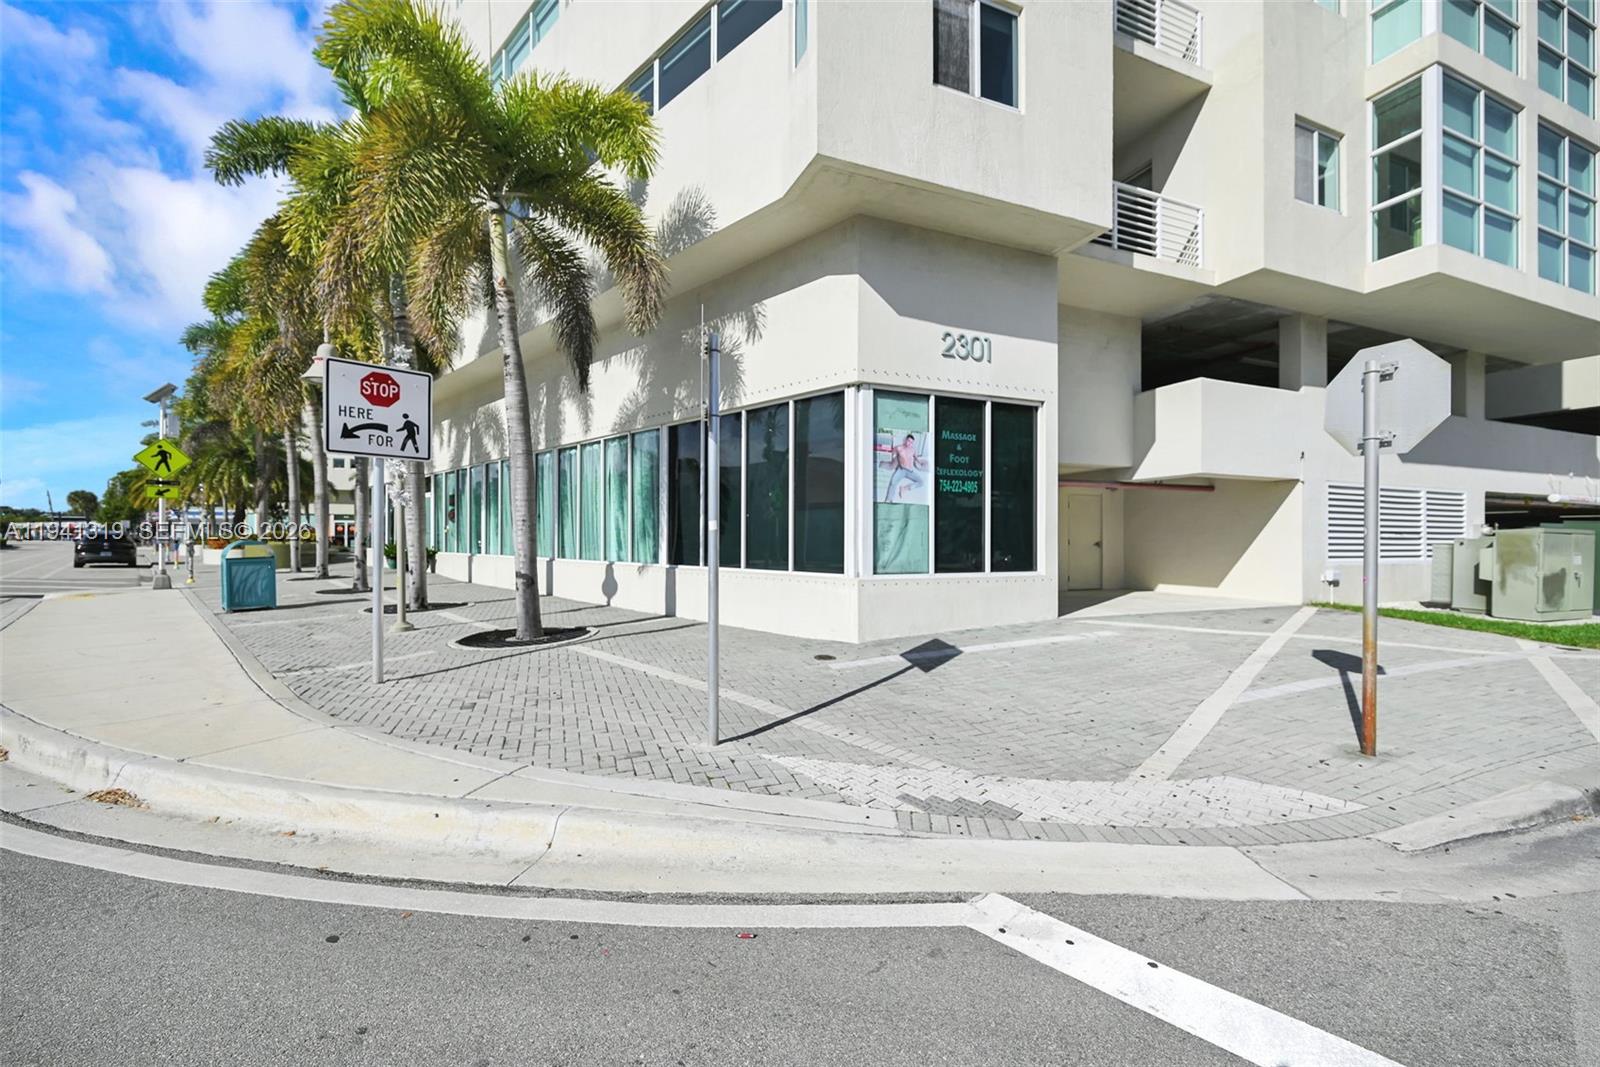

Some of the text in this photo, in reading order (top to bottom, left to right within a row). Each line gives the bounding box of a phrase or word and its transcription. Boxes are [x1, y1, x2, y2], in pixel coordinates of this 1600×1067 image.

[941, 332, 992, 364] 2301
[362, 381, 398, 398] STOP
[338, 404, 373, 420] HERE
[368, 434, 393, 447] FOR
[949, 454, 969, 463] FOOT
